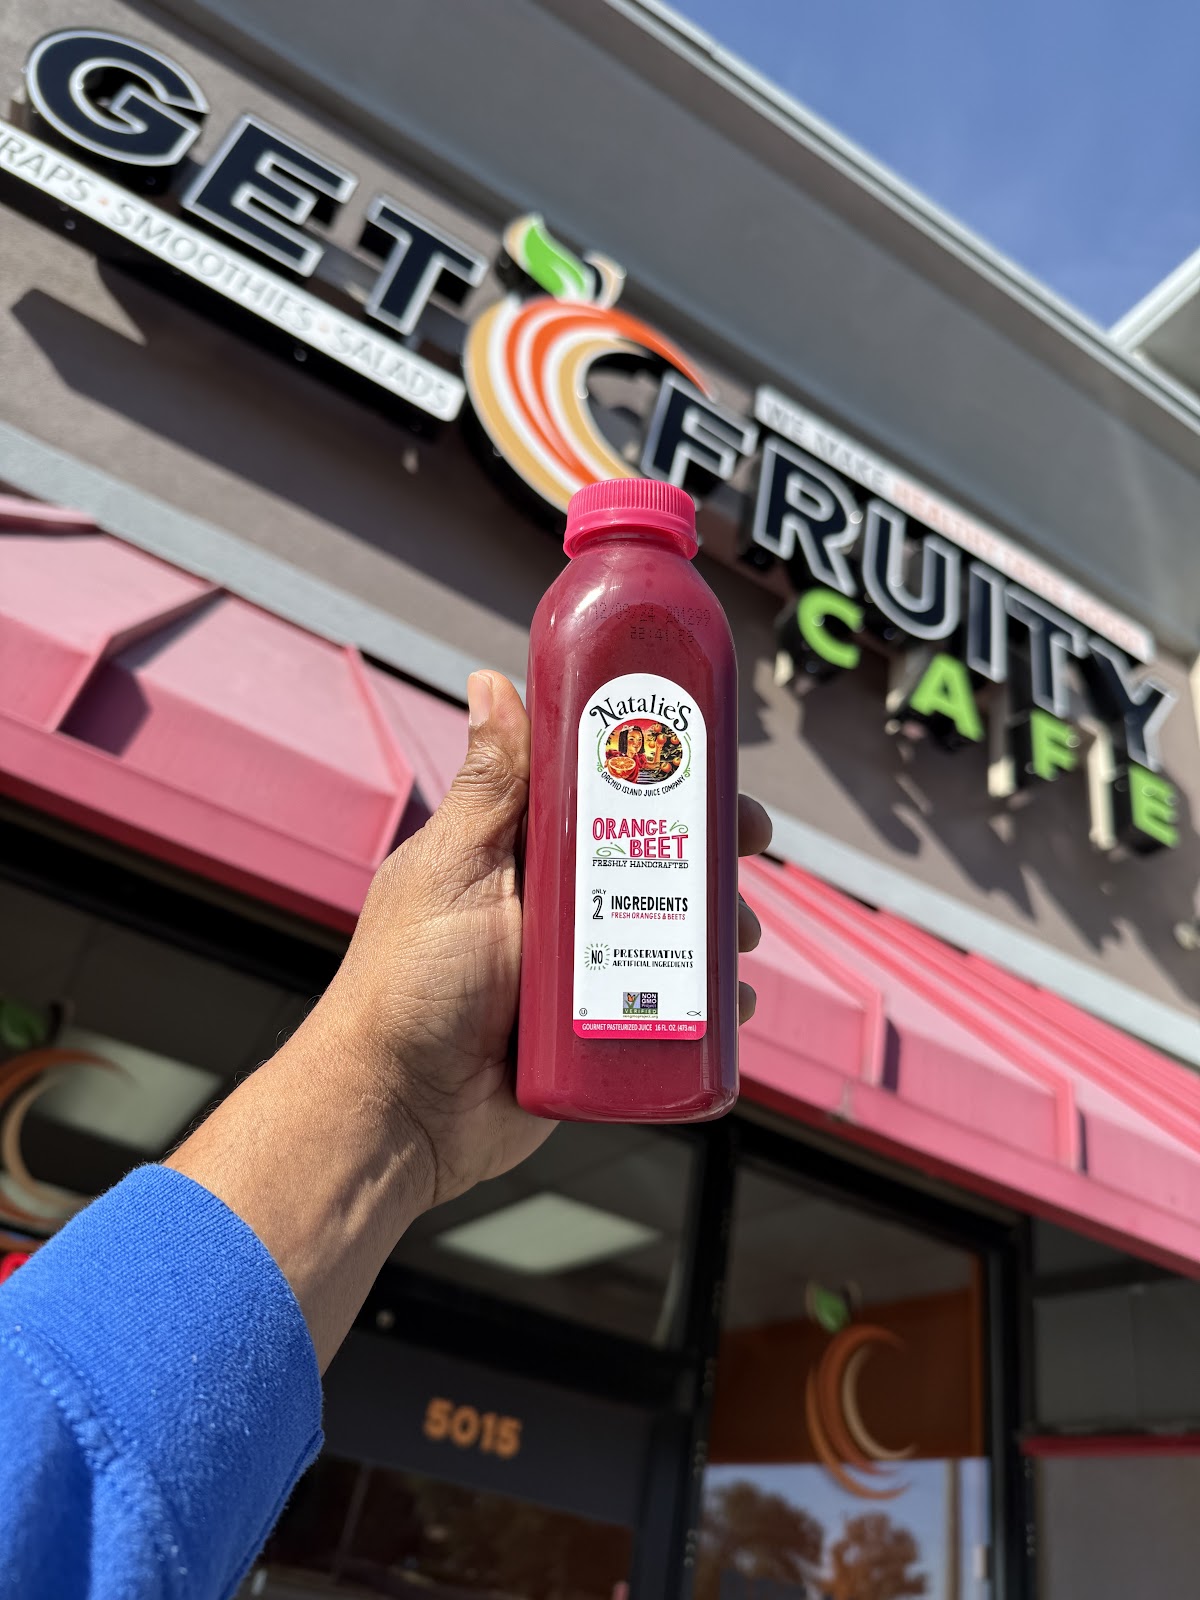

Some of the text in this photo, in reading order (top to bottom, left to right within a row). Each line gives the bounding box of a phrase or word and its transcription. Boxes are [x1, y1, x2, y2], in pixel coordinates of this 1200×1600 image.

[27, 29, 489, 335] GET
[0, 130, 449, 411] RAPS SMOOTHIES SALADS
[641, 372, 1176, 771] FRUITY
[797, 588, 1179, 848] CAFE
[601, 771, 686, 797] ORCHID ISLAND JUICE COMPANY
[592, 817, 667, 840] ORANGE
[629, 834, 689, 859] BEET
[592, 859, 689, 869] FRESHLY HANDCRAFTED
[592, 895, 603, 920] 2
[611, 895, 688, 912] INGREDIENTS
[631, 912, 661, 920] ORANGES
[591, 949, 603, 964] NO
[612, 960, 693, 968] ARTIFICIAL INGREDIENTS
[613, 949, 694, 960] PRESERVATIVES
[582, 1023, 606, 1031] GOURMET
[606, 1023, 638, 1031] PASTEURIZED
[424, 1397, 522, 1459] 5015
